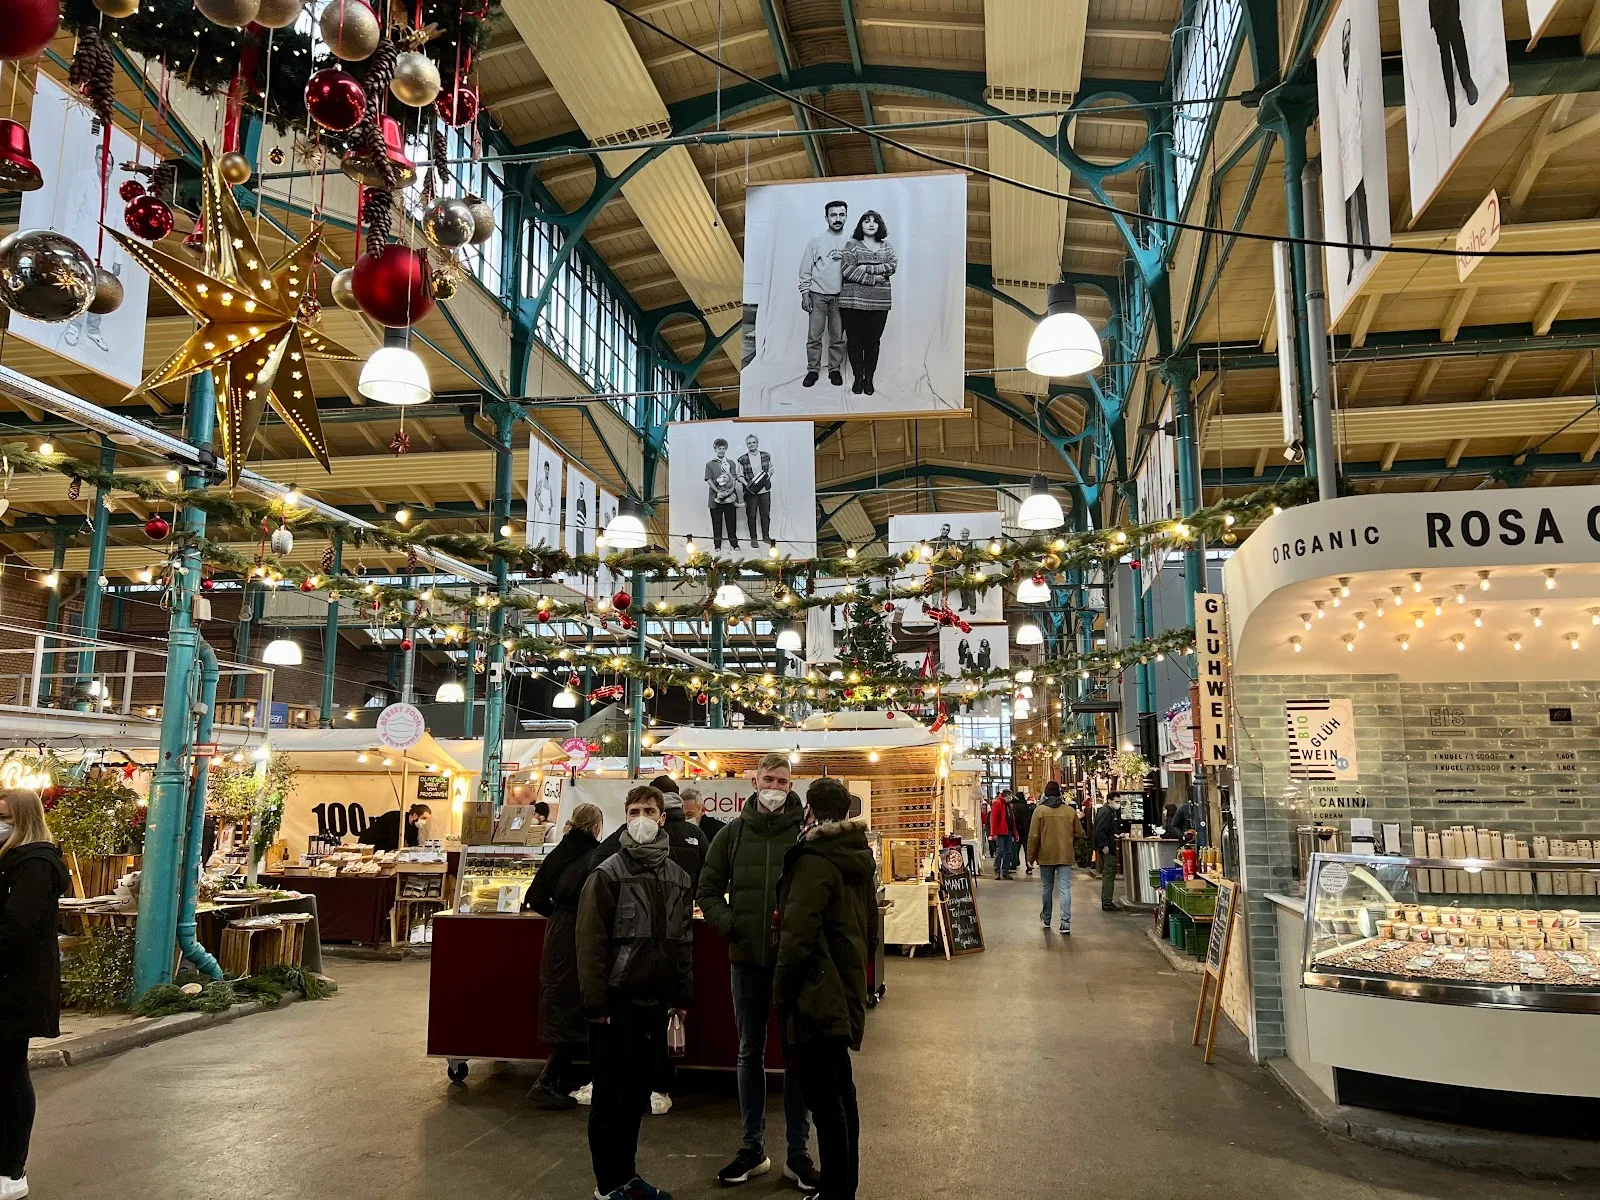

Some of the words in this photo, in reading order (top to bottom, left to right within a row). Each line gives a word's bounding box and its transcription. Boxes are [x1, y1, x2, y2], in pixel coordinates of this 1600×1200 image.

[1457, 227, 1487, 270] Reihe
[1487, 198, 1500, 236] 2
[1426, 507, 1564, 548] ROSA
[1272, 526, 1379, 564] ORGANIC
[1204, 598, 1227, 761] GLÜHWEIN
[1296, 715, 1310, 739] BIO
[1310, 717, 1341, 748] GLÜH
[1430, 708, 1465, 727] EIS
[1301, 749, 1338, 761] WEIN
[1319, 797, 1369, 808] CANINA
[311, 802, 367, 837] 100
[944, 877, 968, 890] MANTI
